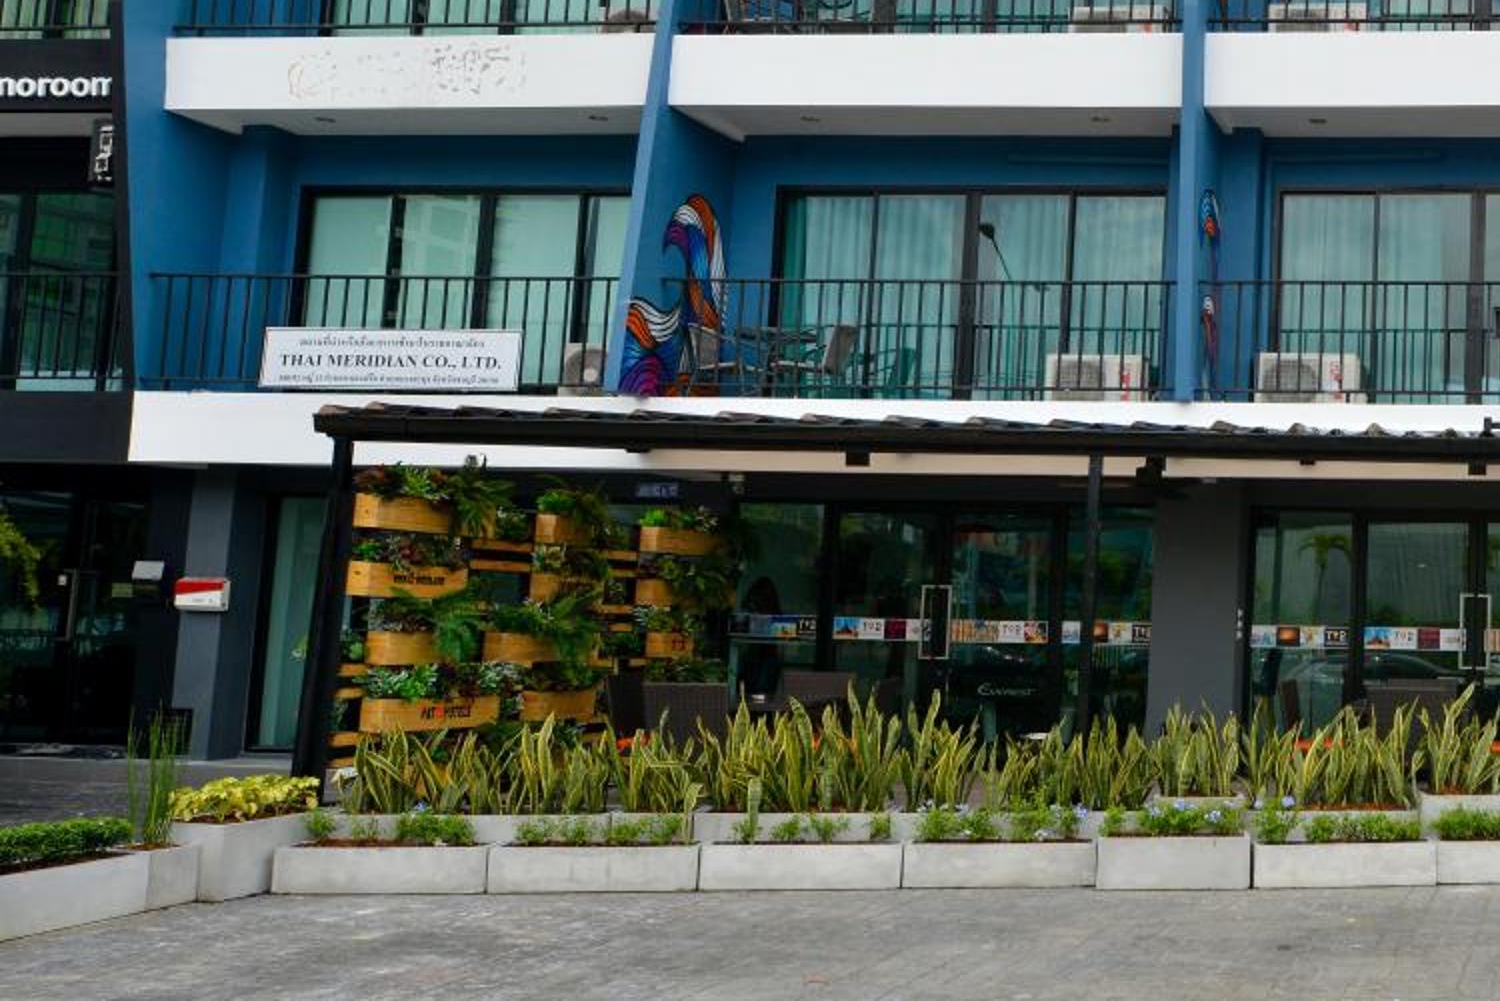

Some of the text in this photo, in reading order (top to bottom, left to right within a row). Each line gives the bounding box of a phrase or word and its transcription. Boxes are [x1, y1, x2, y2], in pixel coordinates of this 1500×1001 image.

[281, 354, 501, 370] THAI MERIDIAN CO., LTD.
